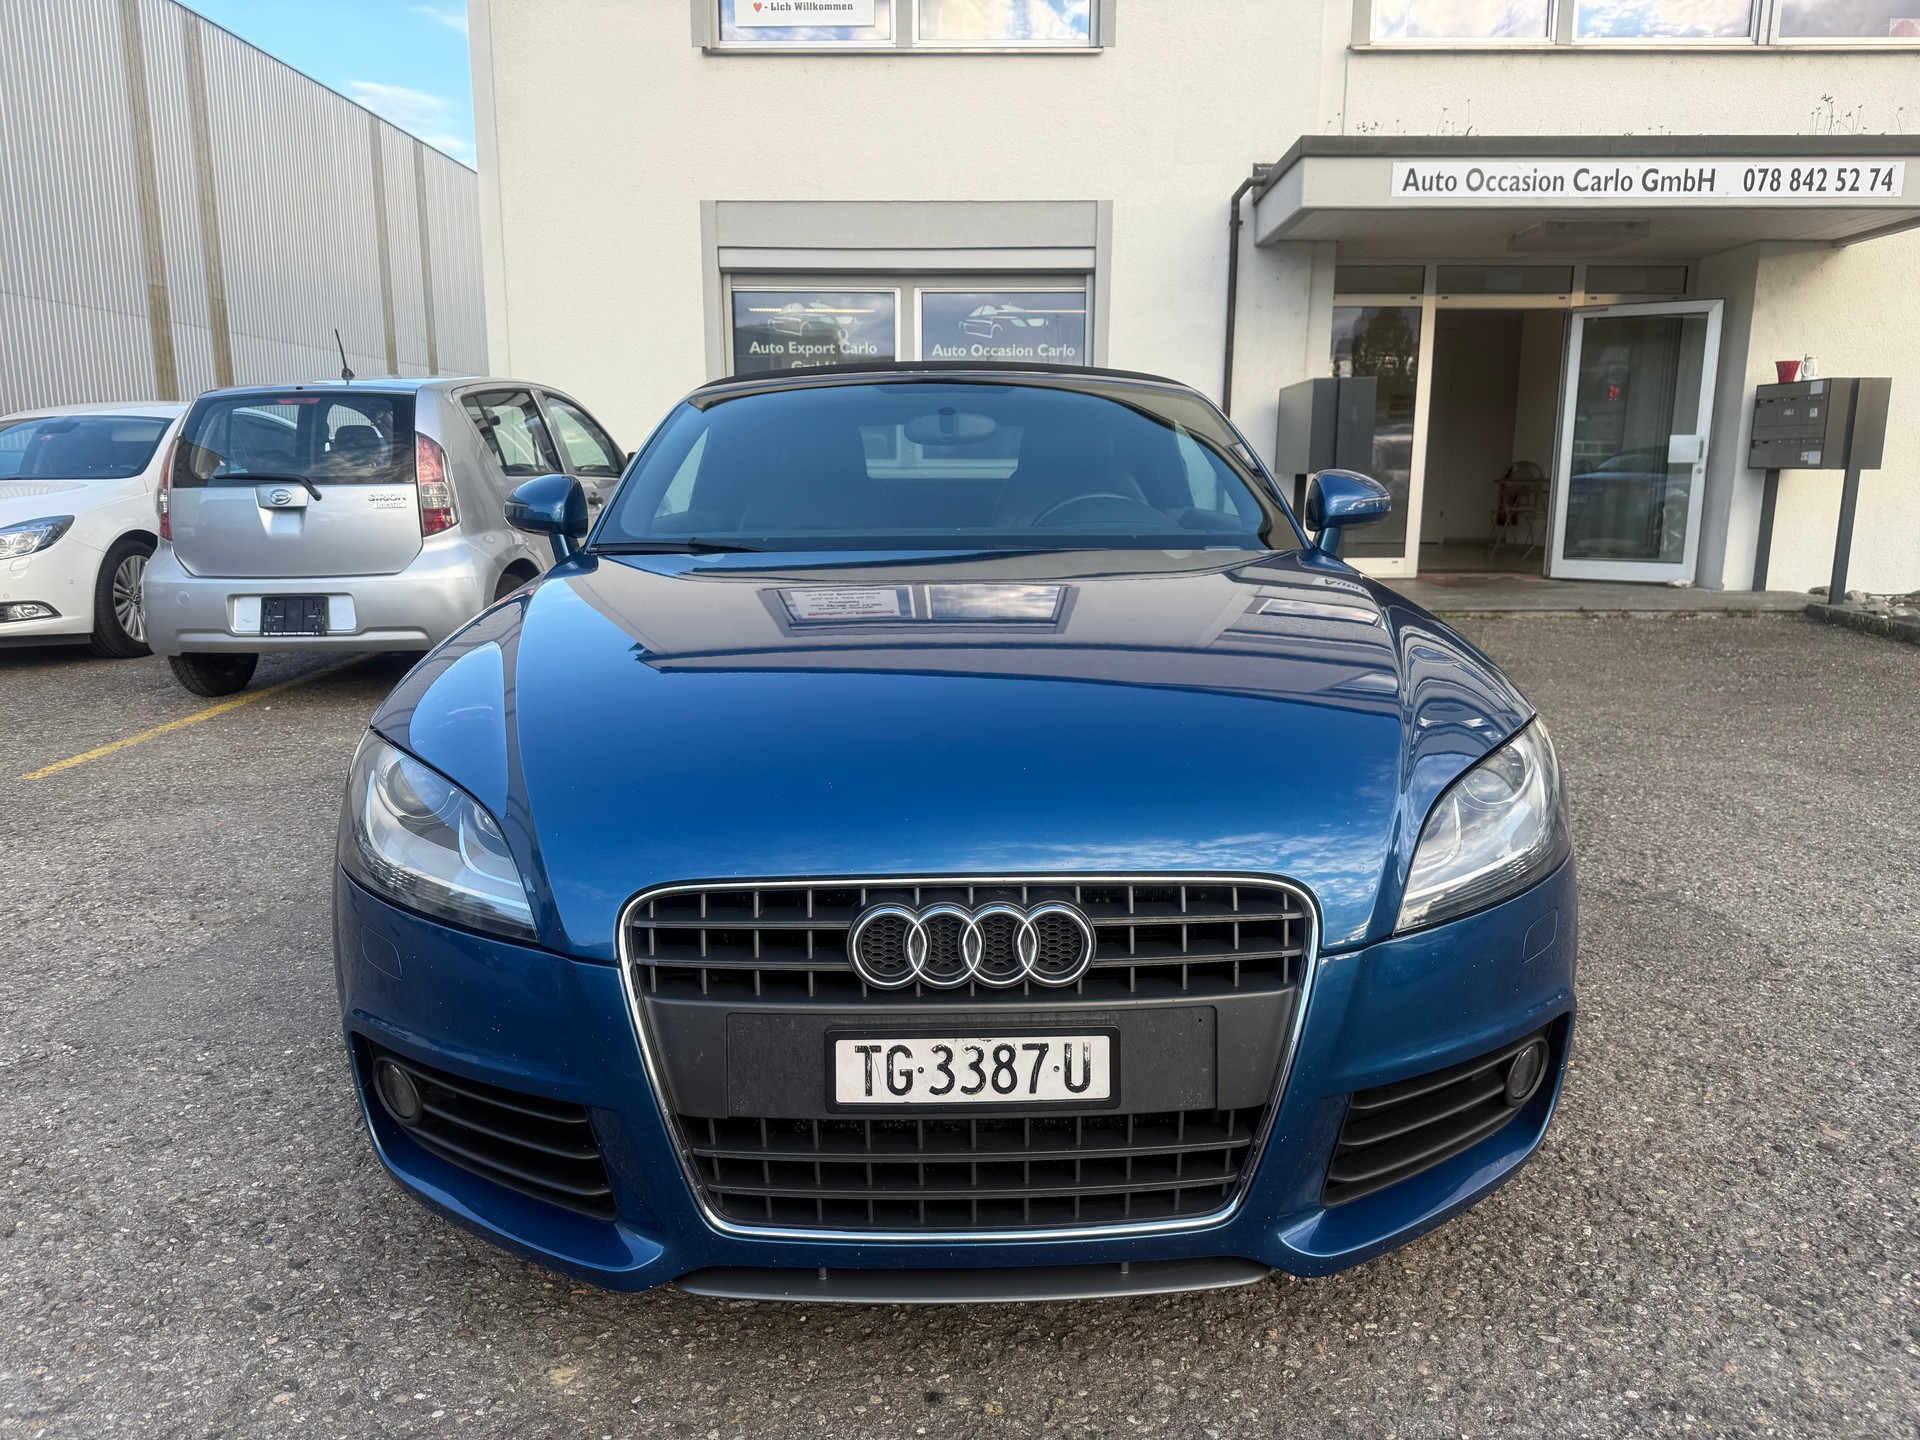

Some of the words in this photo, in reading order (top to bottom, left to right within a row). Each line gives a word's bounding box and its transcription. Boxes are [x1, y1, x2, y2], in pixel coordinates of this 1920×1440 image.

[770, 2, 791, 11] Lich
[794, 2, 853, 11] Willkommen
[1401, 168, 1458, 192] Auto
[1465, 168, 1565, 192] Occasion
[1573, 168, 1634, 192] Carlo
[1641, 168, 1716, 192] GmbH
[1743, 168, 1782, 192] 078
[1789, 168, 1828, 192] 842
[1835, 168, 1860, 192] 52
[1869, 168, 1894, 192] 74
[749, 341, 784, 354] Auto
[788, 341, 836, 357] Export
[840, 342, 878, 354] Carlo
[932, 344, 967, 357] Auto
[970, 344, 1033, 357] Occasion
[1037, 344, 1076, 357] Carlo
